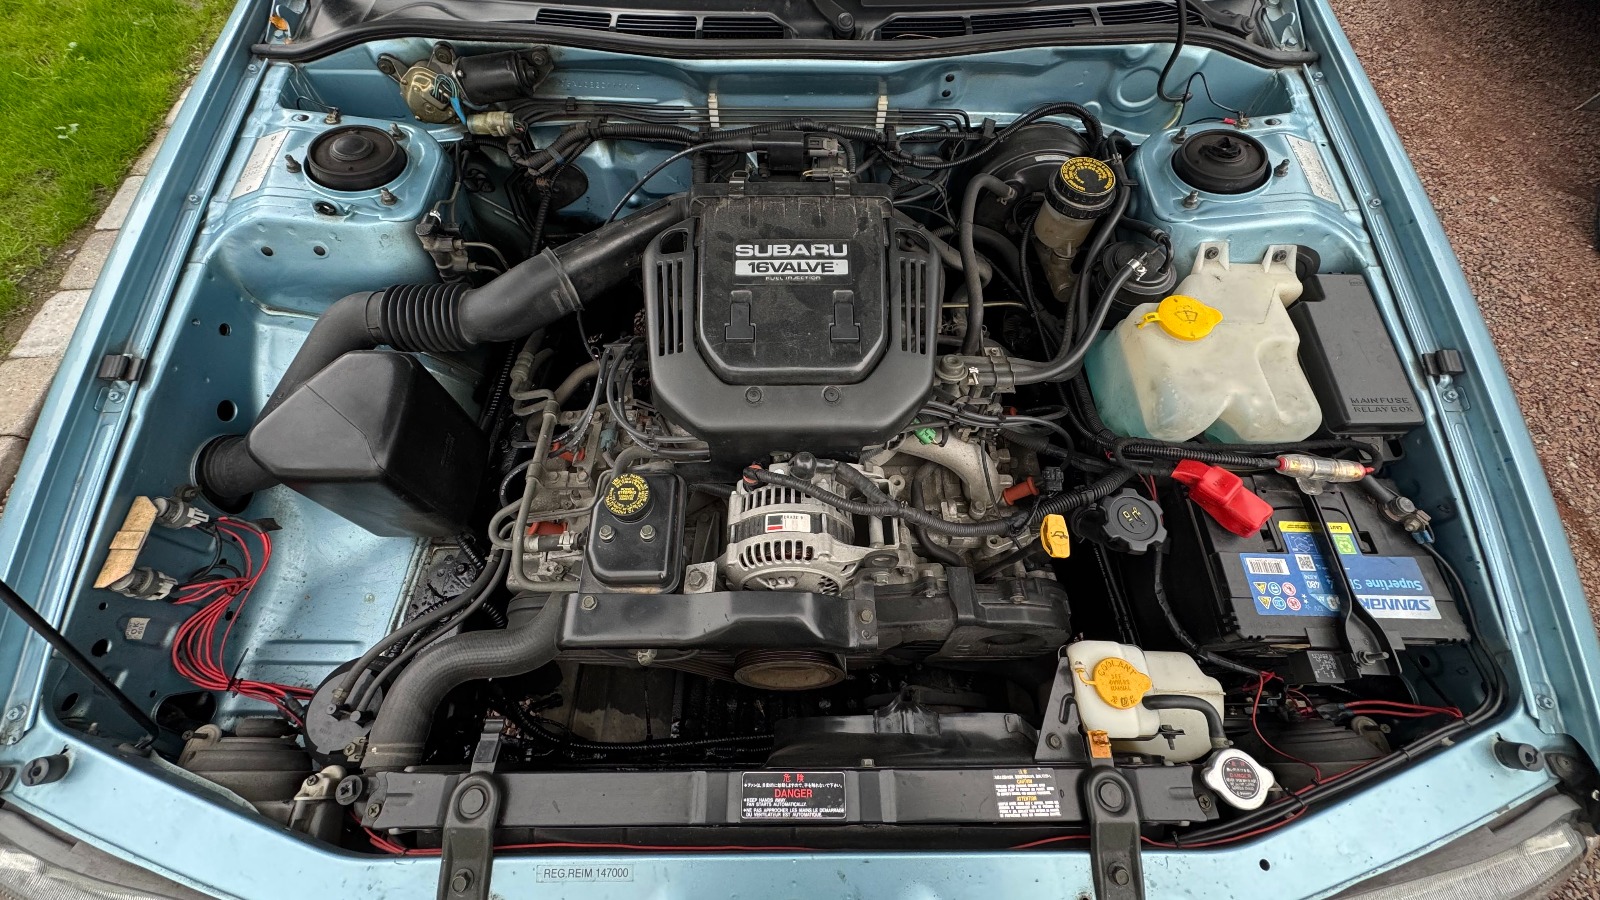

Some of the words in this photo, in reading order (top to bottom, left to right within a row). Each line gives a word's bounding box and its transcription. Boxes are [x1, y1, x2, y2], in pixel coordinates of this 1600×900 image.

[735, 244, 848, 256] SUBARU
[748, 262, 834, 274] 16VALVE
[1366, 578, 1423, 590] Superline
[1098, 660, 1136, 676] COOLANT
[774, 789, 812, 798] DANGER
[544, 868, 592, 878] REG.REIM
[596, 868, 629, 878] 147000
